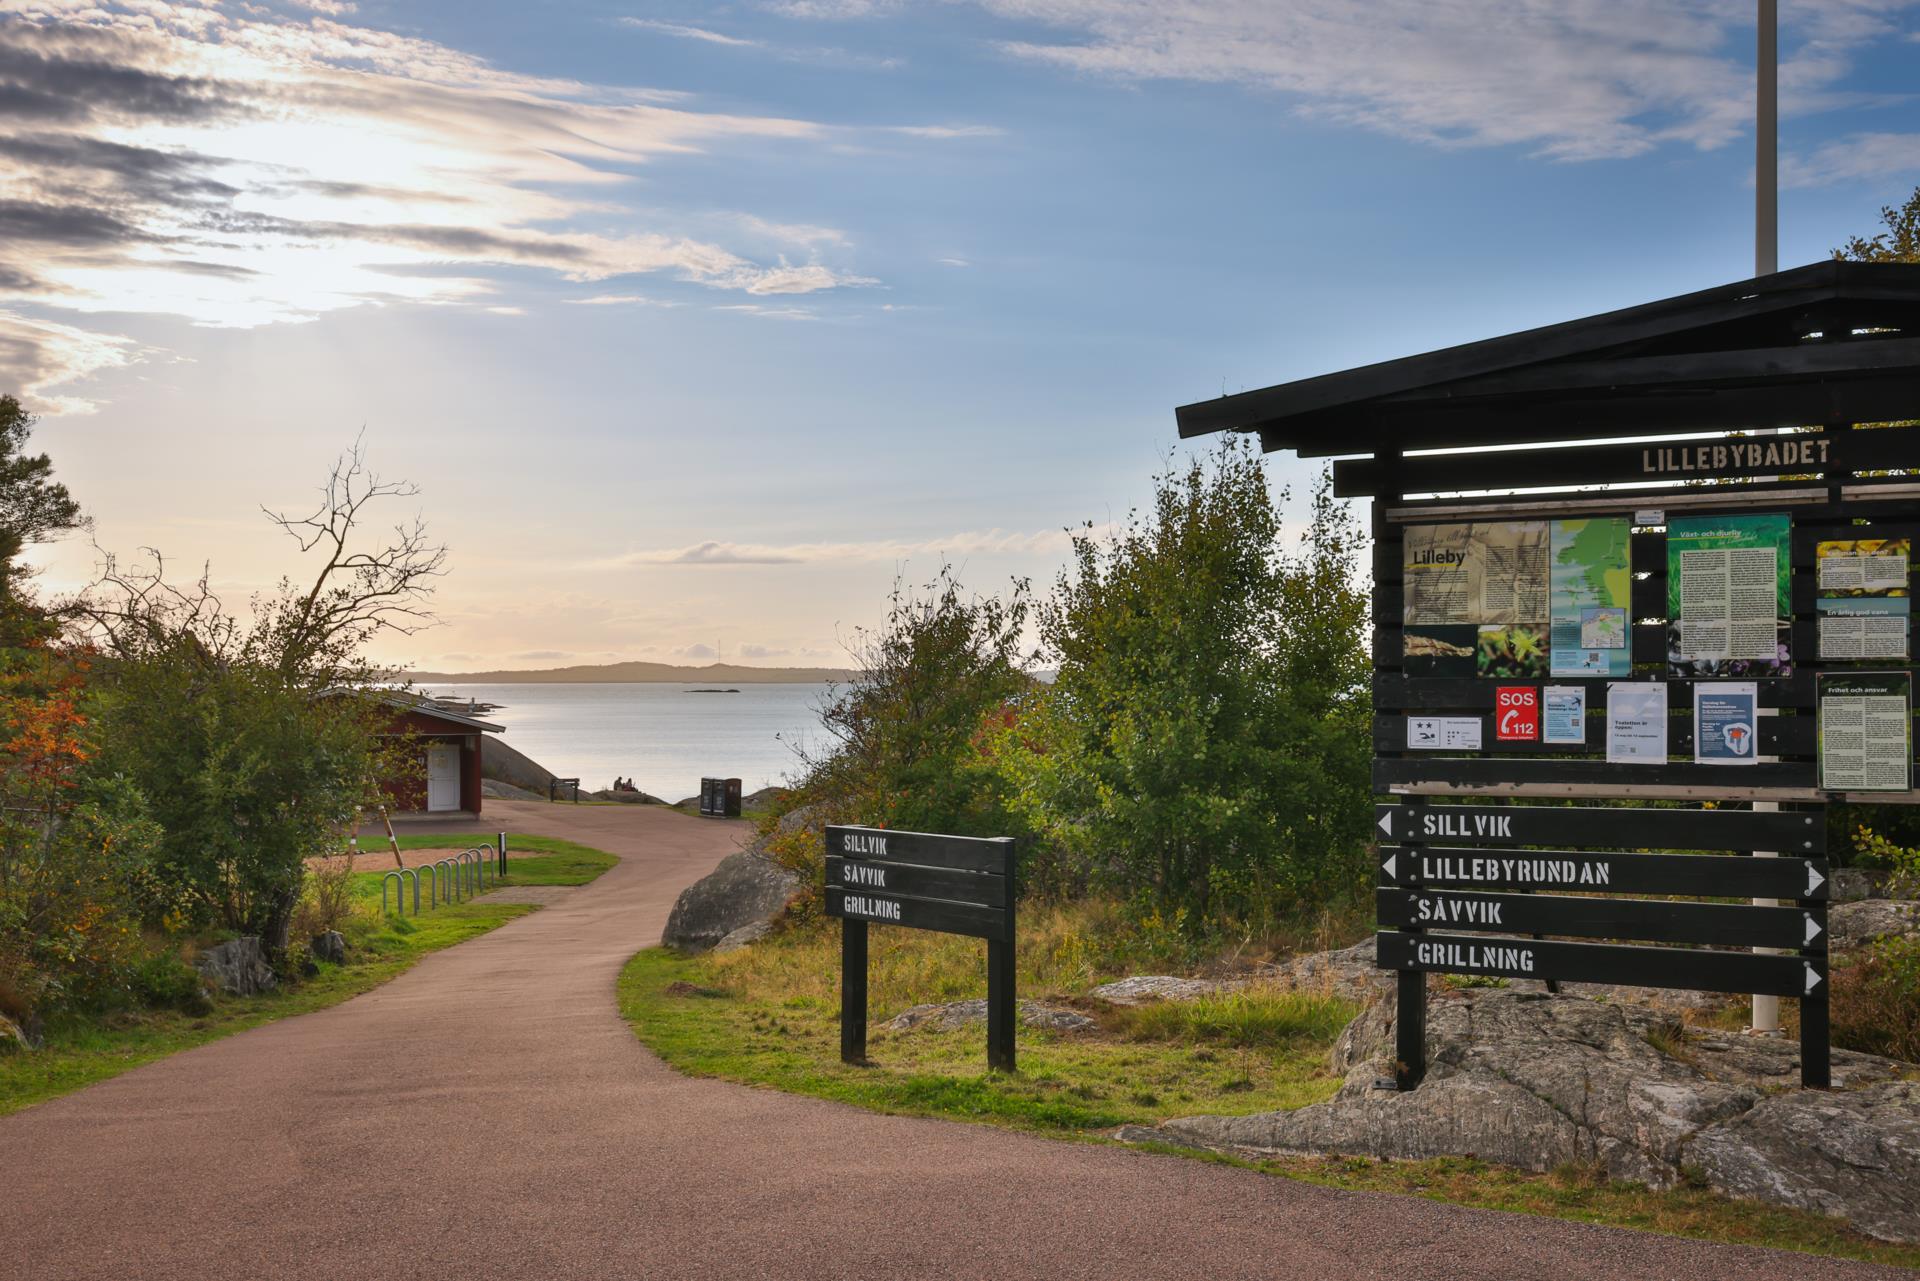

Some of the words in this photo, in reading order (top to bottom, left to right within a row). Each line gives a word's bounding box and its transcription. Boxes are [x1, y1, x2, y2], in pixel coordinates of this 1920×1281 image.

[1643, 439, 1830, 472] LILLEBYBADET
[1414, 549, 1465, 567] Lilleby
[1500, 693, 1534, 706] SOS
[1513, 723, 1534, 734] 112
[1423, 814, 1512, 837] SILLVIK
[844, 834, 887, 855] SILLVIK
[1423, 857, 1610, 885] LILLEBYRUNDAN
[844, 895, 901, 920] GRILLNING
[1418, 897, 1502, 924] SÄVVIK
[1418, 942, 1534, 972] GRILLNING
